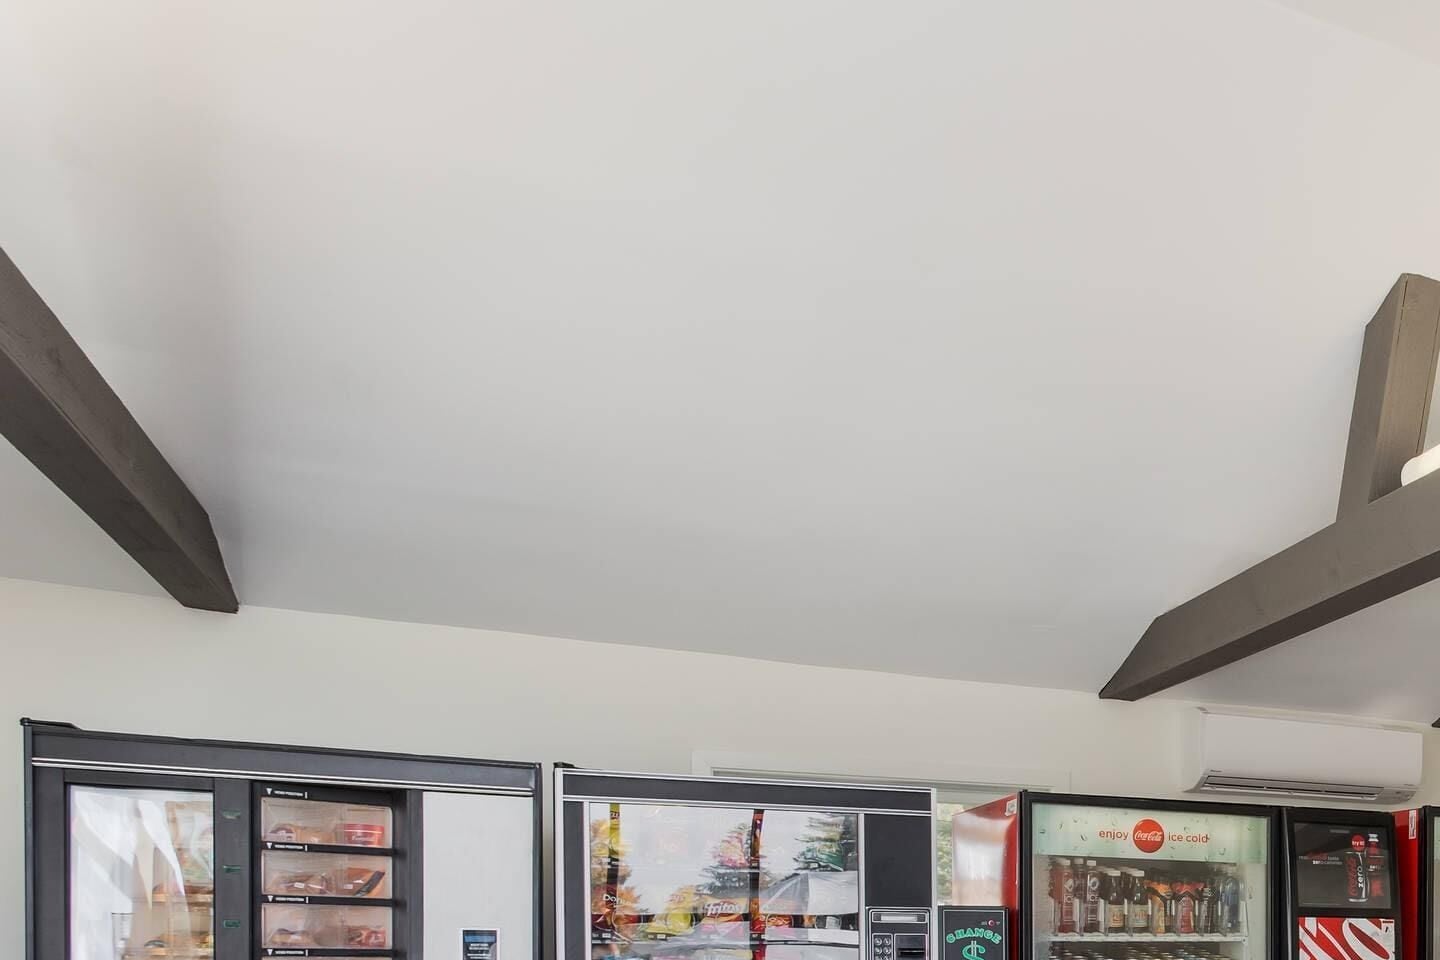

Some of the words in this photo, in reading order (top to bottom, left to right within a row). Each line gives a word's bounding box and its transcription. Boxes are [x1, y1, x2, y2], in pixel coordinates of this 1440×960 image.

[1098, 830, 1129, 840] enjoy
[1168, 832, 1183, 841] ice
[1186, 834, 1208, 843] cold
[946, 927, 1002, 945] CHANGE
